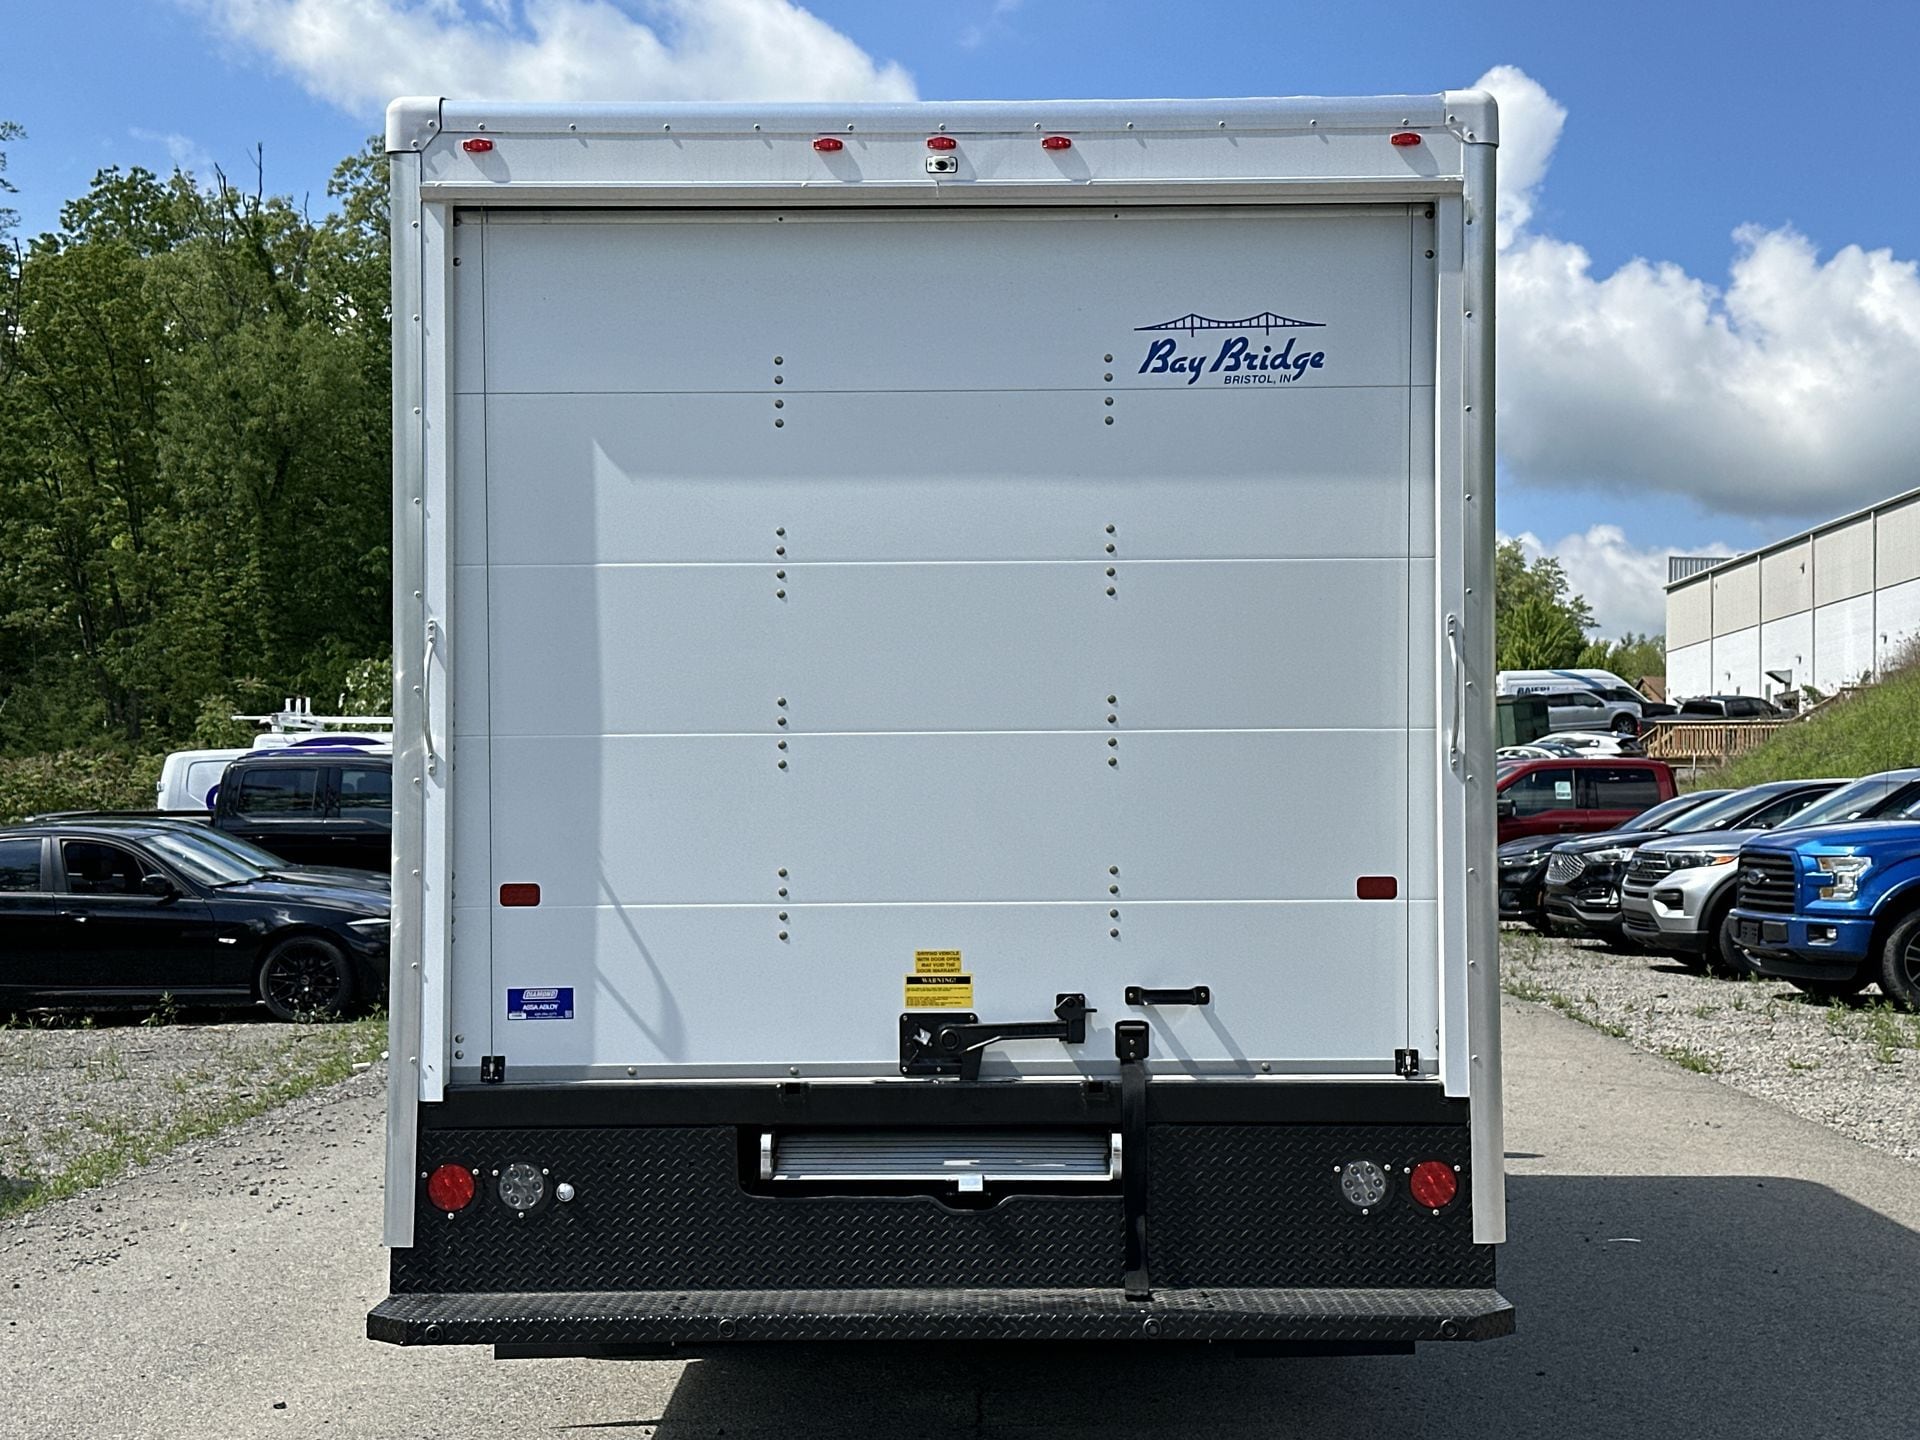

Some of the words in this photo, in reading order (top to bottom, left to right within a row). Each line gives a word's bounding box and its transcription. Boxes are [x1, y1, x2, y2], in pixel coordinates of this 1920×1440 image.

[1138, 338, 1207, 385] Bay
[1208, 336, 1325, 381] Bridge
[1224, 374, 1276, 385] BRISTOL,
[1279, 374, 1293, 383] IN
